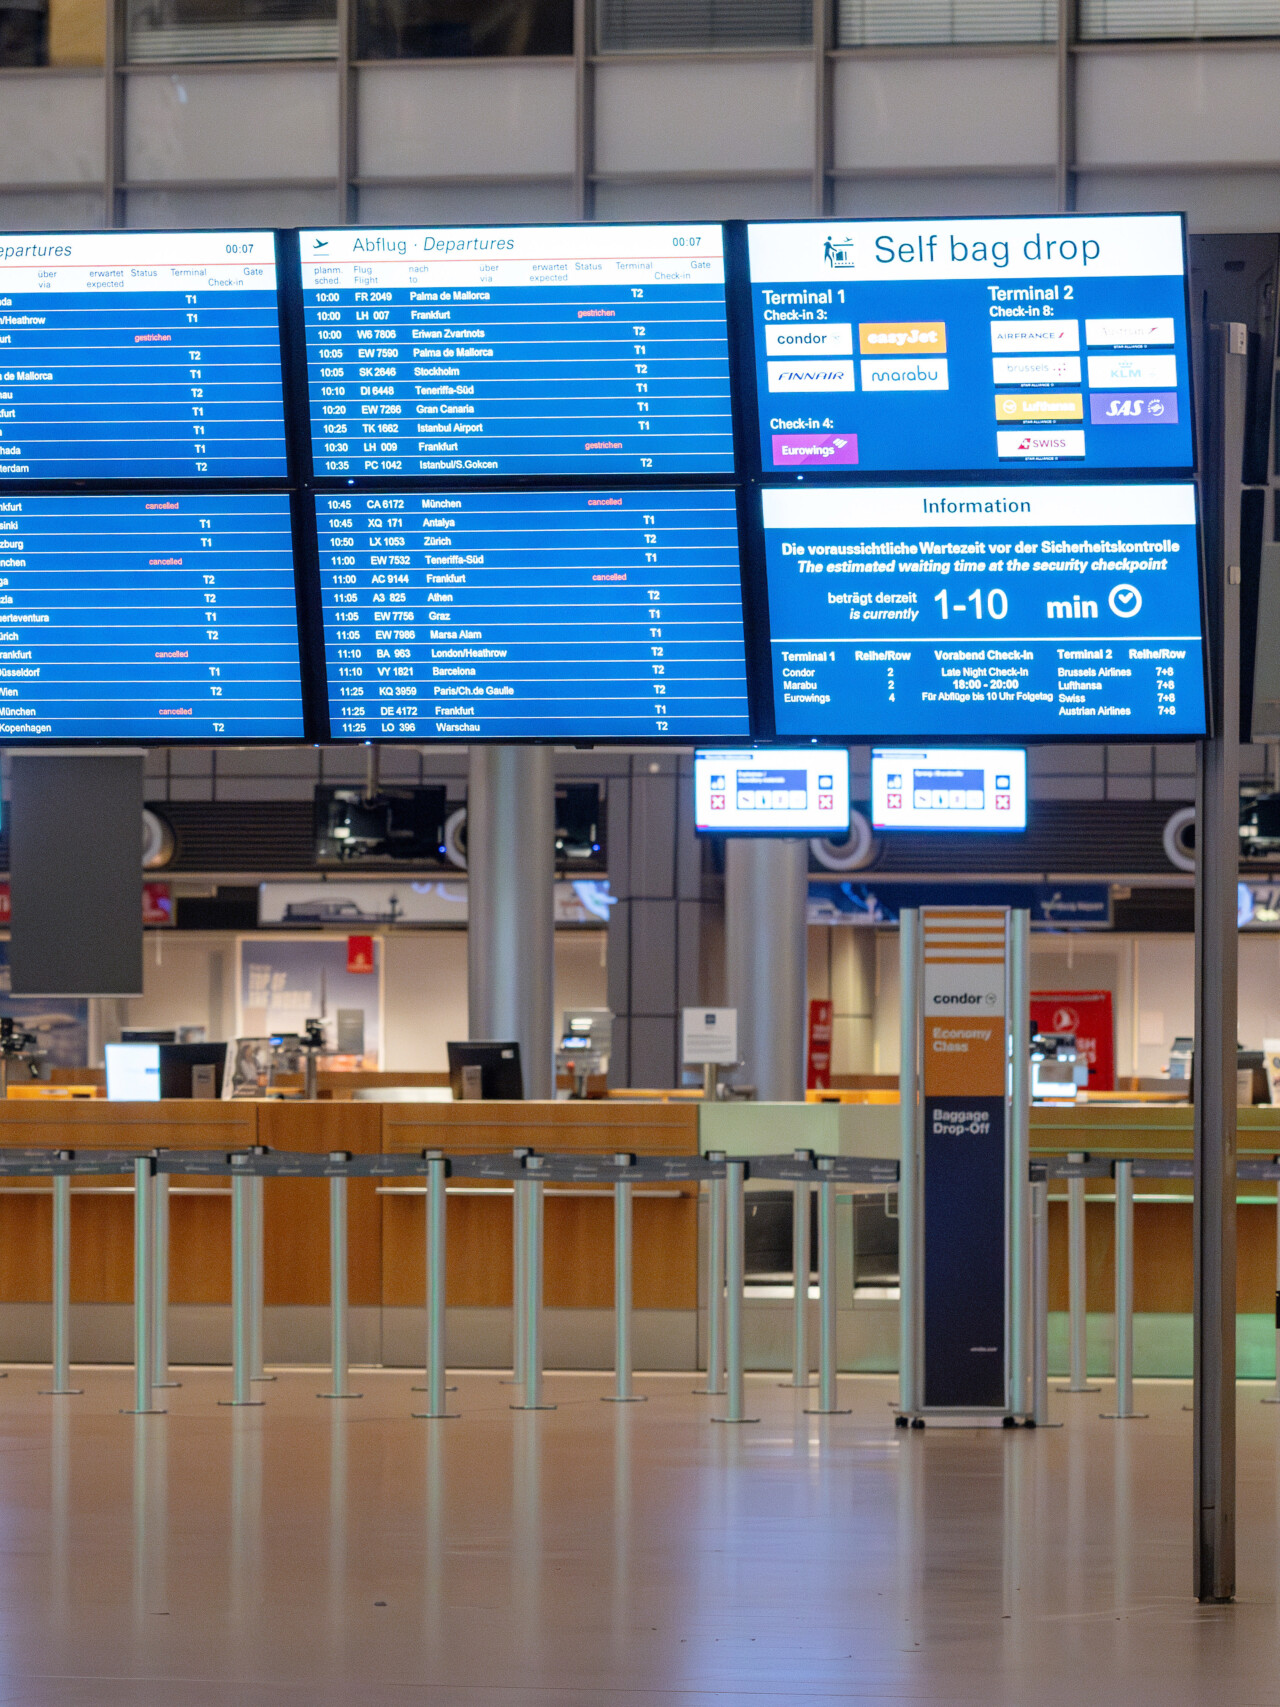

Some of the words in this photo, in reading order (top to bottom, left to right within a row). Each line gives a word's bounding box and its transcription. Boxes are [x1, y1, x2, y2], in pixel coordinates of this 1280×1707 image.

[353, 238, 406, 255] Abflug
[424, 237, 514, 254] Departures
[673, 237, 701, 246] 00:07
[226, 244, 253, 253] 00:07
[875, 235, 937, 263] Self
[951, 235, 1008, 268] bag
[1024, 233, 1100, 266] drop
[762, 289, 831, 304] Terminal
[838, 289, 844, 303] 1
[987, 285, 1059, 301] Terminal
[1064, 285, 1073, 299] 2
[185, 295, 196, 304] T1
[764, 309, 813, 320] Check-in
[817, 309, 827, 320] 3:
[989, 305, 1040, 317] Check-in
[1043, 305, 1054, 316] 8:
[778, 333, 827, 344] condor
[868, 330, 938, 346] easyJet
[320, 368, 344, 377] 10:05
[359, 368, 373, 376] SK
[374, 367, 396, 376] 2646
[414, 367, 459, 376] Stockholm
[635, 364, 647, 373] T2
[778, 372, 844, 380] FINNAIR
[872, 365, 937, 381] marabu
[1111, 369, 1141, 377] KLM
[191, 388, 203, 397] T2
[1106, 400, 1144, 416] SAS
[770, 418, 820, 429] Check-in
[822, 418, 833, 428] 4:
[1033, 439, 1066, 448] SWISS
[782, 445, 835, 457] Eurowings
[924, 498, 1030, 513] Information
[330, 538, 354, 546] 10:50
[370, 537, 382, 546] LX
[384, 537, 405, 546] 1053
[424, 537, 451, 545] Zürich
[644, 534, 656, 543] T2
[782, 543, 805, 555] Die
[808, 542, 918, 555] voraussichtliche
[919, 541, 986, 554] Wartezeit
[988, 544, 1012, 553] vor
[1015, 541, 1038, 553] der
[1041, 540, 1180, 553] Sicherheitskontrolle
[798, 560, 823, 573] The
[826, 560, 896, 572] estimated
[898, 559, 950, 574] waiting
[954, 559, 986, 571] time
[988, 560, 1004, 571] at
[1006, 559, 1030, 571] the
[1033, 558, 1088, 573] security
[1091, 558, 1168, 573] checkpoint
[203, 575, 215, 584] T2
[828, 592, 872, 606] beträgt
[875, 592, 917, 603] derzeit
[934, 588, 1008, 620] 1-10
[1047, 596, 1098, 618] min
[850, 608, 860, 619] is
[863, 608, 919, 622] currently
[782, 652, 827, 661] Terminal
[829, 651, 835, 661] 1
[855, 651, 911, 660] Reihe/Row
[934, 650, 984, 660] Vorabend
[1057, 649, 1100, 659] Terminal
[1106, 649, 1112, 659] 2
[1129, 649, 1186, 659] Reihe/Row
[783, 668, 815, 677] Condor
[888, 668, 894, 676] 2
[941, 668, 961, 676] Late
[963, 667, 987, 678] Night
[1058, 667, 1096, 677] Brussels
[1098, 667, 1131, 676] Airlines
[1156, 667, 1174, 676] 7+8
[784, 681, 817, 689] Marabu
[888, 680, 894, 689] 2
[953, 679, 981, 689] 18:00
[991, 679, 1019, 689] 20:00
[1058, 681, 1102, 690] Lufthansa
[1157, 680, 1175, 689] 7+8
[784, 693, 830, 704] Eurowings
[889, 693, 895, 702] 4
[922, 692, 937, 700] Für
[938, 692, 970, 702] Abflüge
[972, 692, 984, 700] bis
[987, 692, 997, 700] 10
[999, 692, 1015, 700] Uhr
[1016, 692, 1053, 702] Folgetag
[1059, 694, 1085, 703] Swiss
[1157, 693, 1175, 702] 7+8
[1059, 707, 1096, 715] Austrian
[1098, 706, 1131, 715] Airlines
[1158, 706, 1176, 715] 7+8
[934, 993, 982, 1004] condor
[933, 1027, 992, 1042] Economy
[933, 1041, 969, 1053] Class
[933, 1109, 989, 1123] Baggage
[933, 1122, 990, 1135] Drop-Off
